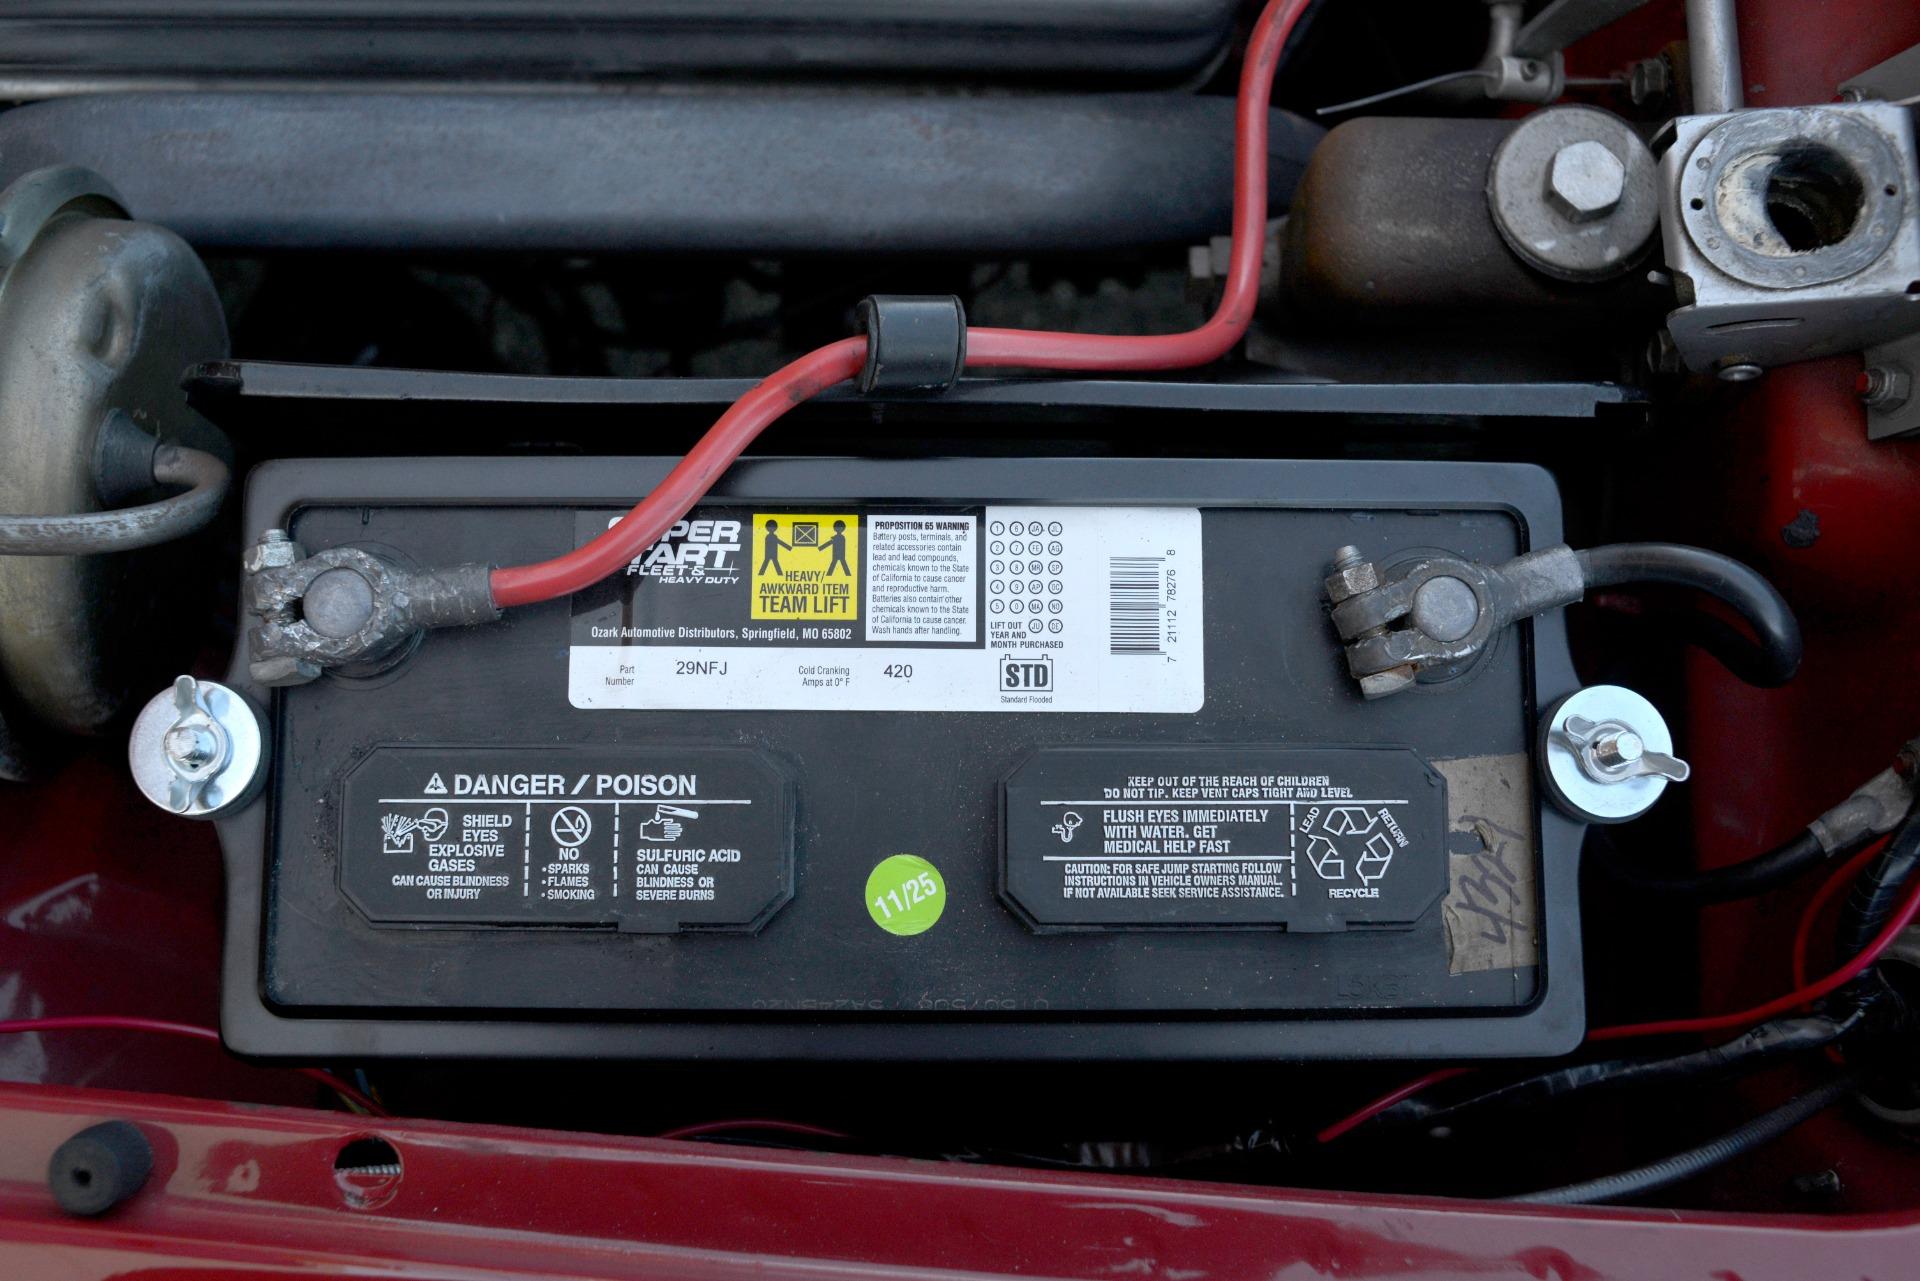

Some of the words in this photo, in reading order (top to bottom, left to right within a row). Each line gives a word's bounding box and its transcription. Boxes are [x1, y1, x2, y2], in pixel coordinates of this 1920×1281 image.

[608, 517, 741, 542] PER
[875, 521, 923, 530] PROPOSITION
[925, 522, 934, 530] 65
[936, 522, 969, 531] WARNING
[873, 532, 897, 542] Battery
[898, 533, 919, 541] posts,
[920, 533, 953, 541] terminals,
[955, 533, 968, 541] and
[873, 543, 895, 551] related
[937, 544, 962, 552] contain
[631, 543, 741, 567] ART
[873, 553, 886, 561] lead
[888, 553, 900, 561] and
[918, 554, 959, 563] compounds,
[626, 564, 688, 576] FLEET
[691, 565, 705, 576] &
[873, 564, 905, 572] chemicals
[907, 564, 930, 572] known
[931, 564, 938, 572] to
[940, 564, 950, 572] the
[952, 564, 969, 573] State
[659, 576, 703, 584] HEAVY
[785, 570, 825, 583] HEAVY/
[872, 573, 880, 582] of
[881, 573, 912, 582] California
[914, 574, 921, 582] to
[923, 575, 942, 583] cause
[944, 575, 966, 583] cancer
[760, 583, 818, 594] AWKWARD
[822, 583, 849, 594] ITEM
[872, 584, 884, 592] and
[886, 584, 928, 593] reproductive
[930, 585, 950, 593] harm.
[1166, 569, 1177, 602] 78276
[759, 596, 807, 613] TEAM
[813, 596, 850, 613] LIFT
[872, 594, 901, 603] Batteries
[903, 595, 917, 603] also
[918, 595, 943, 603] contain
[944, 595, 962, 603] other
[872, 605, 905, 613] chemicals
[907, 605, 930, 613] known
[939, 605, 950, 613] the
[952, 606, 969, 614] State
[871, 626, 891, 634] Wash
[892, 626, 913, 634] hands
[914, 626, 930, 634] after
[931, 626, 962, 636] handling.
[990, 621, 1006, 630] LIFT
[1007, 621, 1023, 630] OUT
[591, 627, 619, 639] Ozark
[620, 627, 675, 639] Automotive
[678, 627, 739, 640] Distributors,
[741, 627, 800, 641] Springfield,
[802, 628, 819, 639] MO
[821, 628, 852, 640] 65802
[990, 631, 1010, 639] YEAR
[1011, 631, 1027, 639] AND
[990, 640, 1017, 649] MONTH
[1020, 641, 1064, 649] PURCHASED
[619, 664, 635, 674] Part
[676, 661, 728, 675] 29NFJ
[798, 665, 816, 675] Cold
[817, 665, 850, 677] Cranking
[883, 664, 913, 678] 420
[605, 677, 635, 686] Number
[1005, 663, 1049, 688] STD
[802, 678, 824, 688] Amps
[825, 678, 833, 686] at
[834, 677, 843, 687] 0°
[845, 678, 850, 686] F
[1000, 695, 1028, 704] Standard
[1029, 696, 1053, 704] Flooded
[454, 774, 565, 796] DANGER
[570, 774, 590, 795] /
[596, 774, 697, 796] POISON
[1128, 776, 1154, 787] KEEP
[1157, 776, 1179, 787] OUT
[1182, 776, 1196, 787] OF
[1198, 776, 1219, 787] THE
[1222, 776, 1257, 787] REACH
[1260, 776, 1275, 787] OF
[1277, 776, 1330, 787] CHILDREN
[1103, 788, 1120, 799] DO
[1123, 788, 1145, 799] NOT
[1147, 788, 1169, 799] TIP.
[1172, 788, 1199, 799] KEEP
[1200, 788, 1229, 798] VENT
[1231, 788, 1259, 798] CAPS
[1262, 788, 1294, 798] TIGHT
[1295, 788, 1318, 798] AND
[1321, 787, 1353, 798] LEVEL
[462, 815, 513, 828] SHIELD
[1103, 809, 1144, 823] FLUSH
[1147, 809, 1179, 823] EYES
[1182, 809, 1269, 823] IMMEDIATELY
[1299, 806, 1320, 834] LEAD
[1103, 825, 1137, 839] WITH
[1140, 825, 1189, 839] WATER.
[1193, 825, 1218, 839] GET
[1377, 807, 1410, 849] RETURN
[462, 829, 499, 843] EYES
[428, 844, 505, 857] EXPLOSIVE
[1103, 840, 1161, 854] MEDICAL
[1163, 840, 1196, 854] HELP
[1199, 840, 1231, 853] FAST
[558, 848, 580, 861] NO
[636, 849, 706, 862] SULFURIC
[708, 849, 741, 862] ACID
[428, 859, 476, 872] GASES
[547, 863, 590, 875] SPARKS
[636, 864, 659, 875] CAN
[663, 864, 699, 875] CAUSE
[1064, 863, 1110, 875] CAUTION:
[1112, 863, 1133, 874] FOR
[1135, 863, 1160, 874] SAFE
[1161, 863, 1190, 874] JUMP
[1191, 863, 1240, 874] STARTING
[1241, 863, 1282, 874] FOLLOW
[392, 875, 415, 886] CAN
[416, 875, 451, 886] CAUSE
[452, 875, 510, 887] BLINDNESS
[547, 876, 589, 887] FLAMES
[636, 876, 694, 888] BLINDNESS
[698, 877, 714, 888] OR
[1064, 875, 1136, 886] INSTRUCTIONS
[1138, 875, 1149, 886] IN
[1150, 875, 1192, 886] VEHICLE
[1193, 875, 1236, 886] OWNERS
[1238, 875, 1283, 886] MANUAL.
[426, 888, 442, 899] OR
[444, 888, 481, 900] INJURY
[547, 889, 595, 900] SMOKING
[635, 889, 677, 901] SEVERE
[678, 889, 715, 901] BURNS
[875, 871, 937, 919] 11/25
[1063, 887, 1073, 899] IF
[1075, 887, 1096, 898] NOT
[1097, 887, 1150, 898] AVAILABLE
[1151, 887, 1177, 898] SEEK
[1178, 887, 1219, 898] SERVICE
[1221, 887, 1285, 898] ASSISTANCE.
[1329, 888, 1380, 899] RECYCLE
